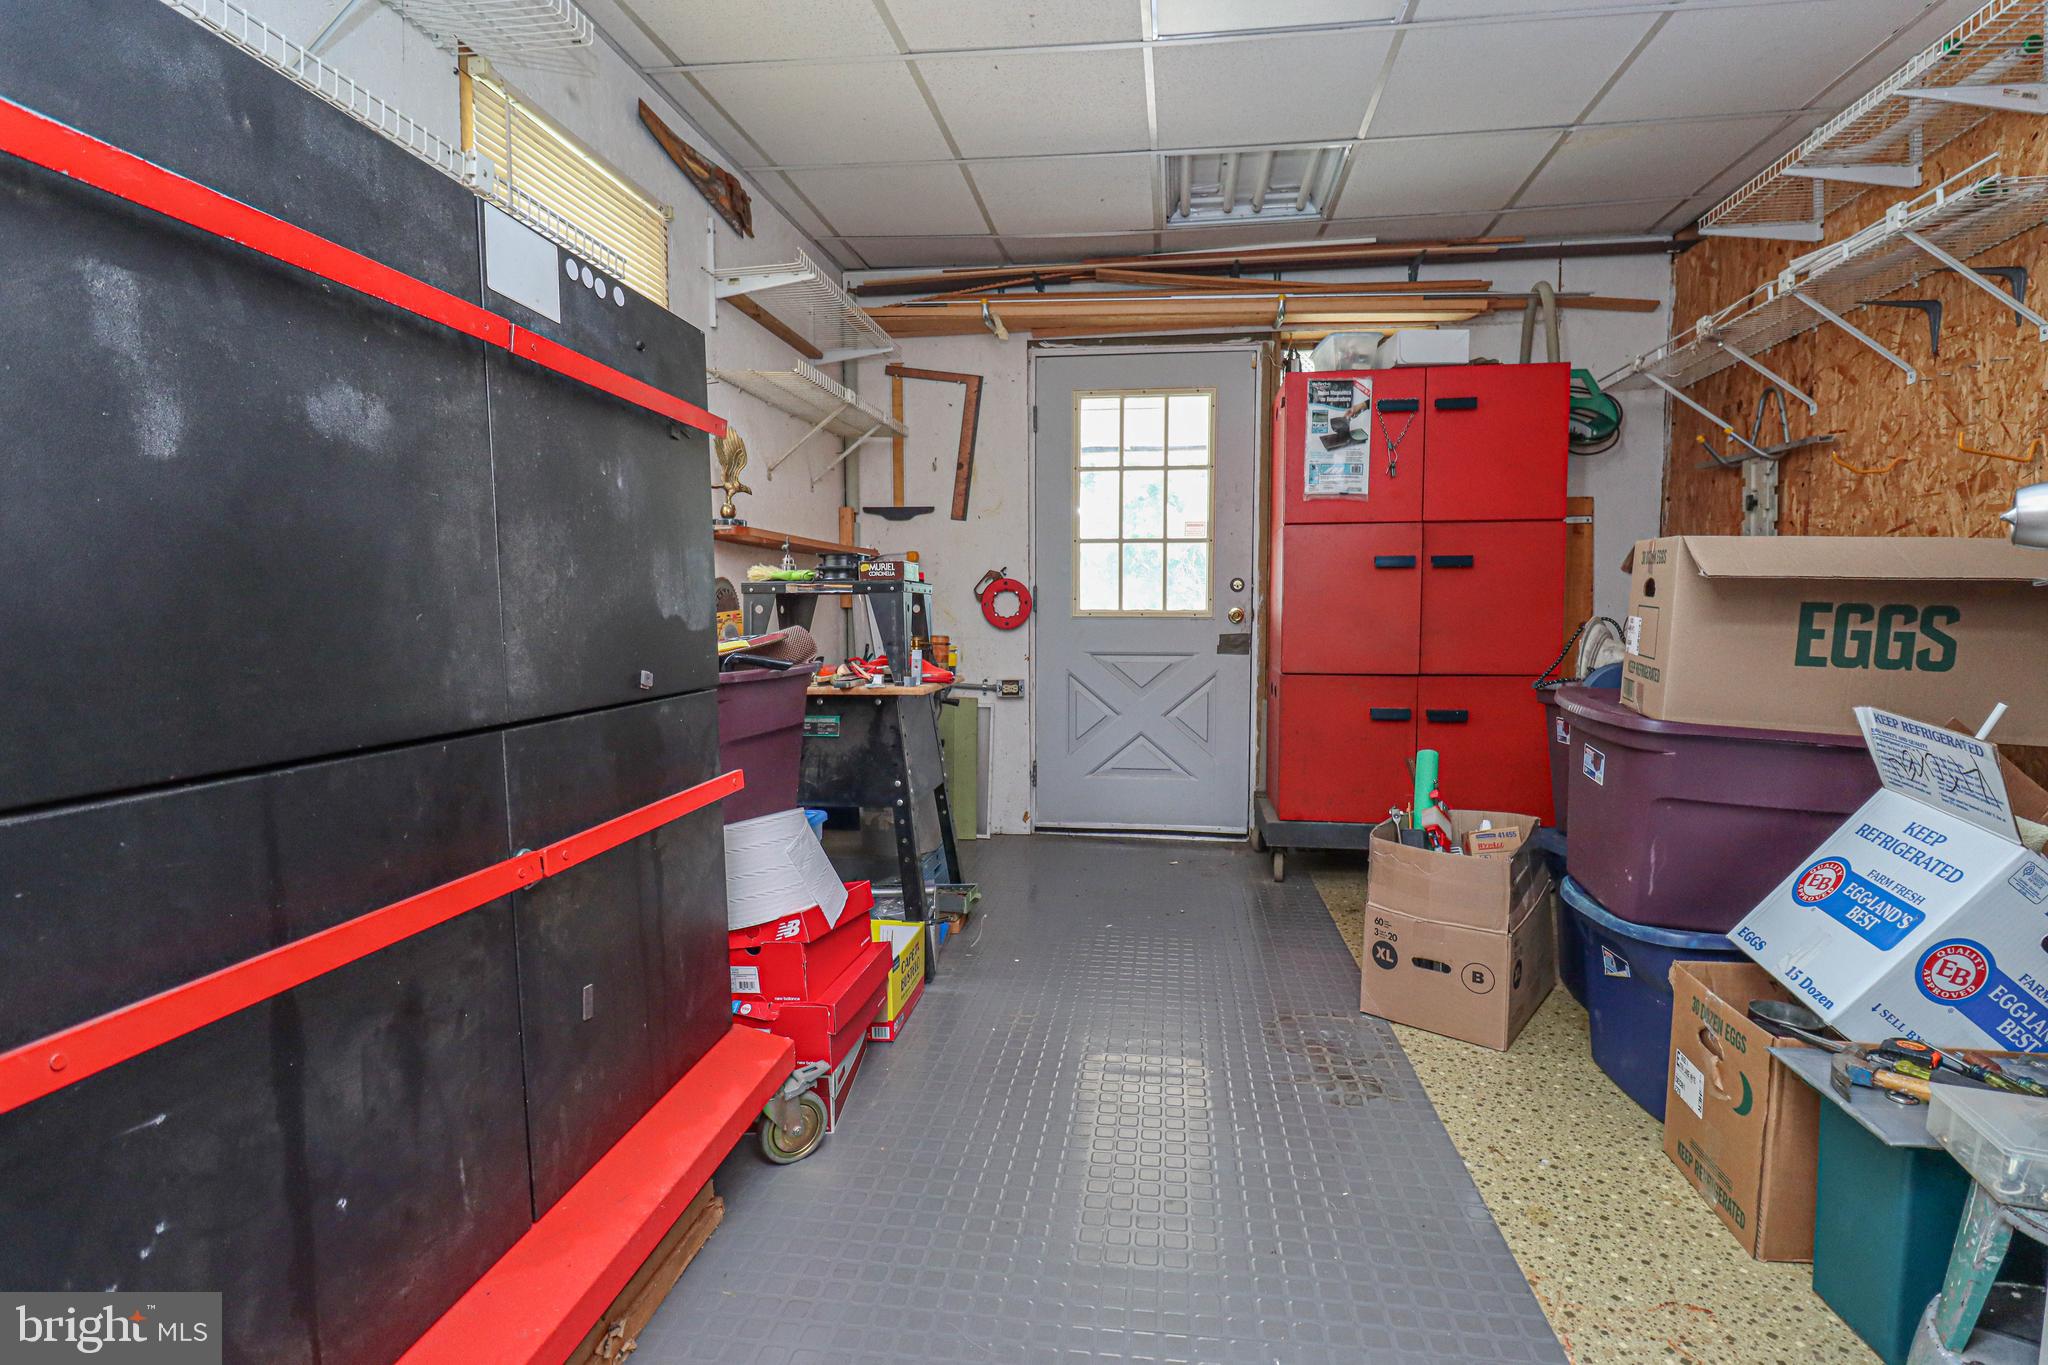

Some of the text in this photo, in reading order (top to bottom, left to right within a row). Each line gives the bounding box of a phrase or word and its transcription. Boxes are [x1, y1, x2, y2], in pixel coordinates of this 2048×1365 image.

[869, 563, 895, 571] MURIEL
[1794, 602, 1961, 672] EGGS
[1873, 712, 1985, 758] KEEP REFRIGERATED
[1902, 821, 1948, 847] KEEP
[1855, 823, 1965, 884] REFRIGERATED
[1806, 873, 1833, 891] EB
[1809, 862, 1844, 877] QUALITY
[1798, 883, 1835, 902] APPROVED
[1867, 869, 1926, 906] FARM FRESH
[1374, 917, 1384, 926] 60
[1845, 905, 1881, 931] BEST
[1374, 928, 1379, 936] 3
[1388, 932, 1398, 942] 20
[1737, 926, 1767, 951] EGGS
[1376, 945, 1394, 963] XL
[1936, 946, 1985, 971] QUALITY
[1471, 971, 1485, 985] B
[1923, 968, 1976, 999] APPROVED
[1936, 958, 1971, 988] EB
[1785, 966, 1836, 1010] 15 Dozen
[1879, 1006, 1907, 1033] SELL
[1724, 1023, 1747, 1054] EGGS
[1996, 1018, 2043, 1053] BEST
[1677, 1139, 1693, 1167] KEEP
